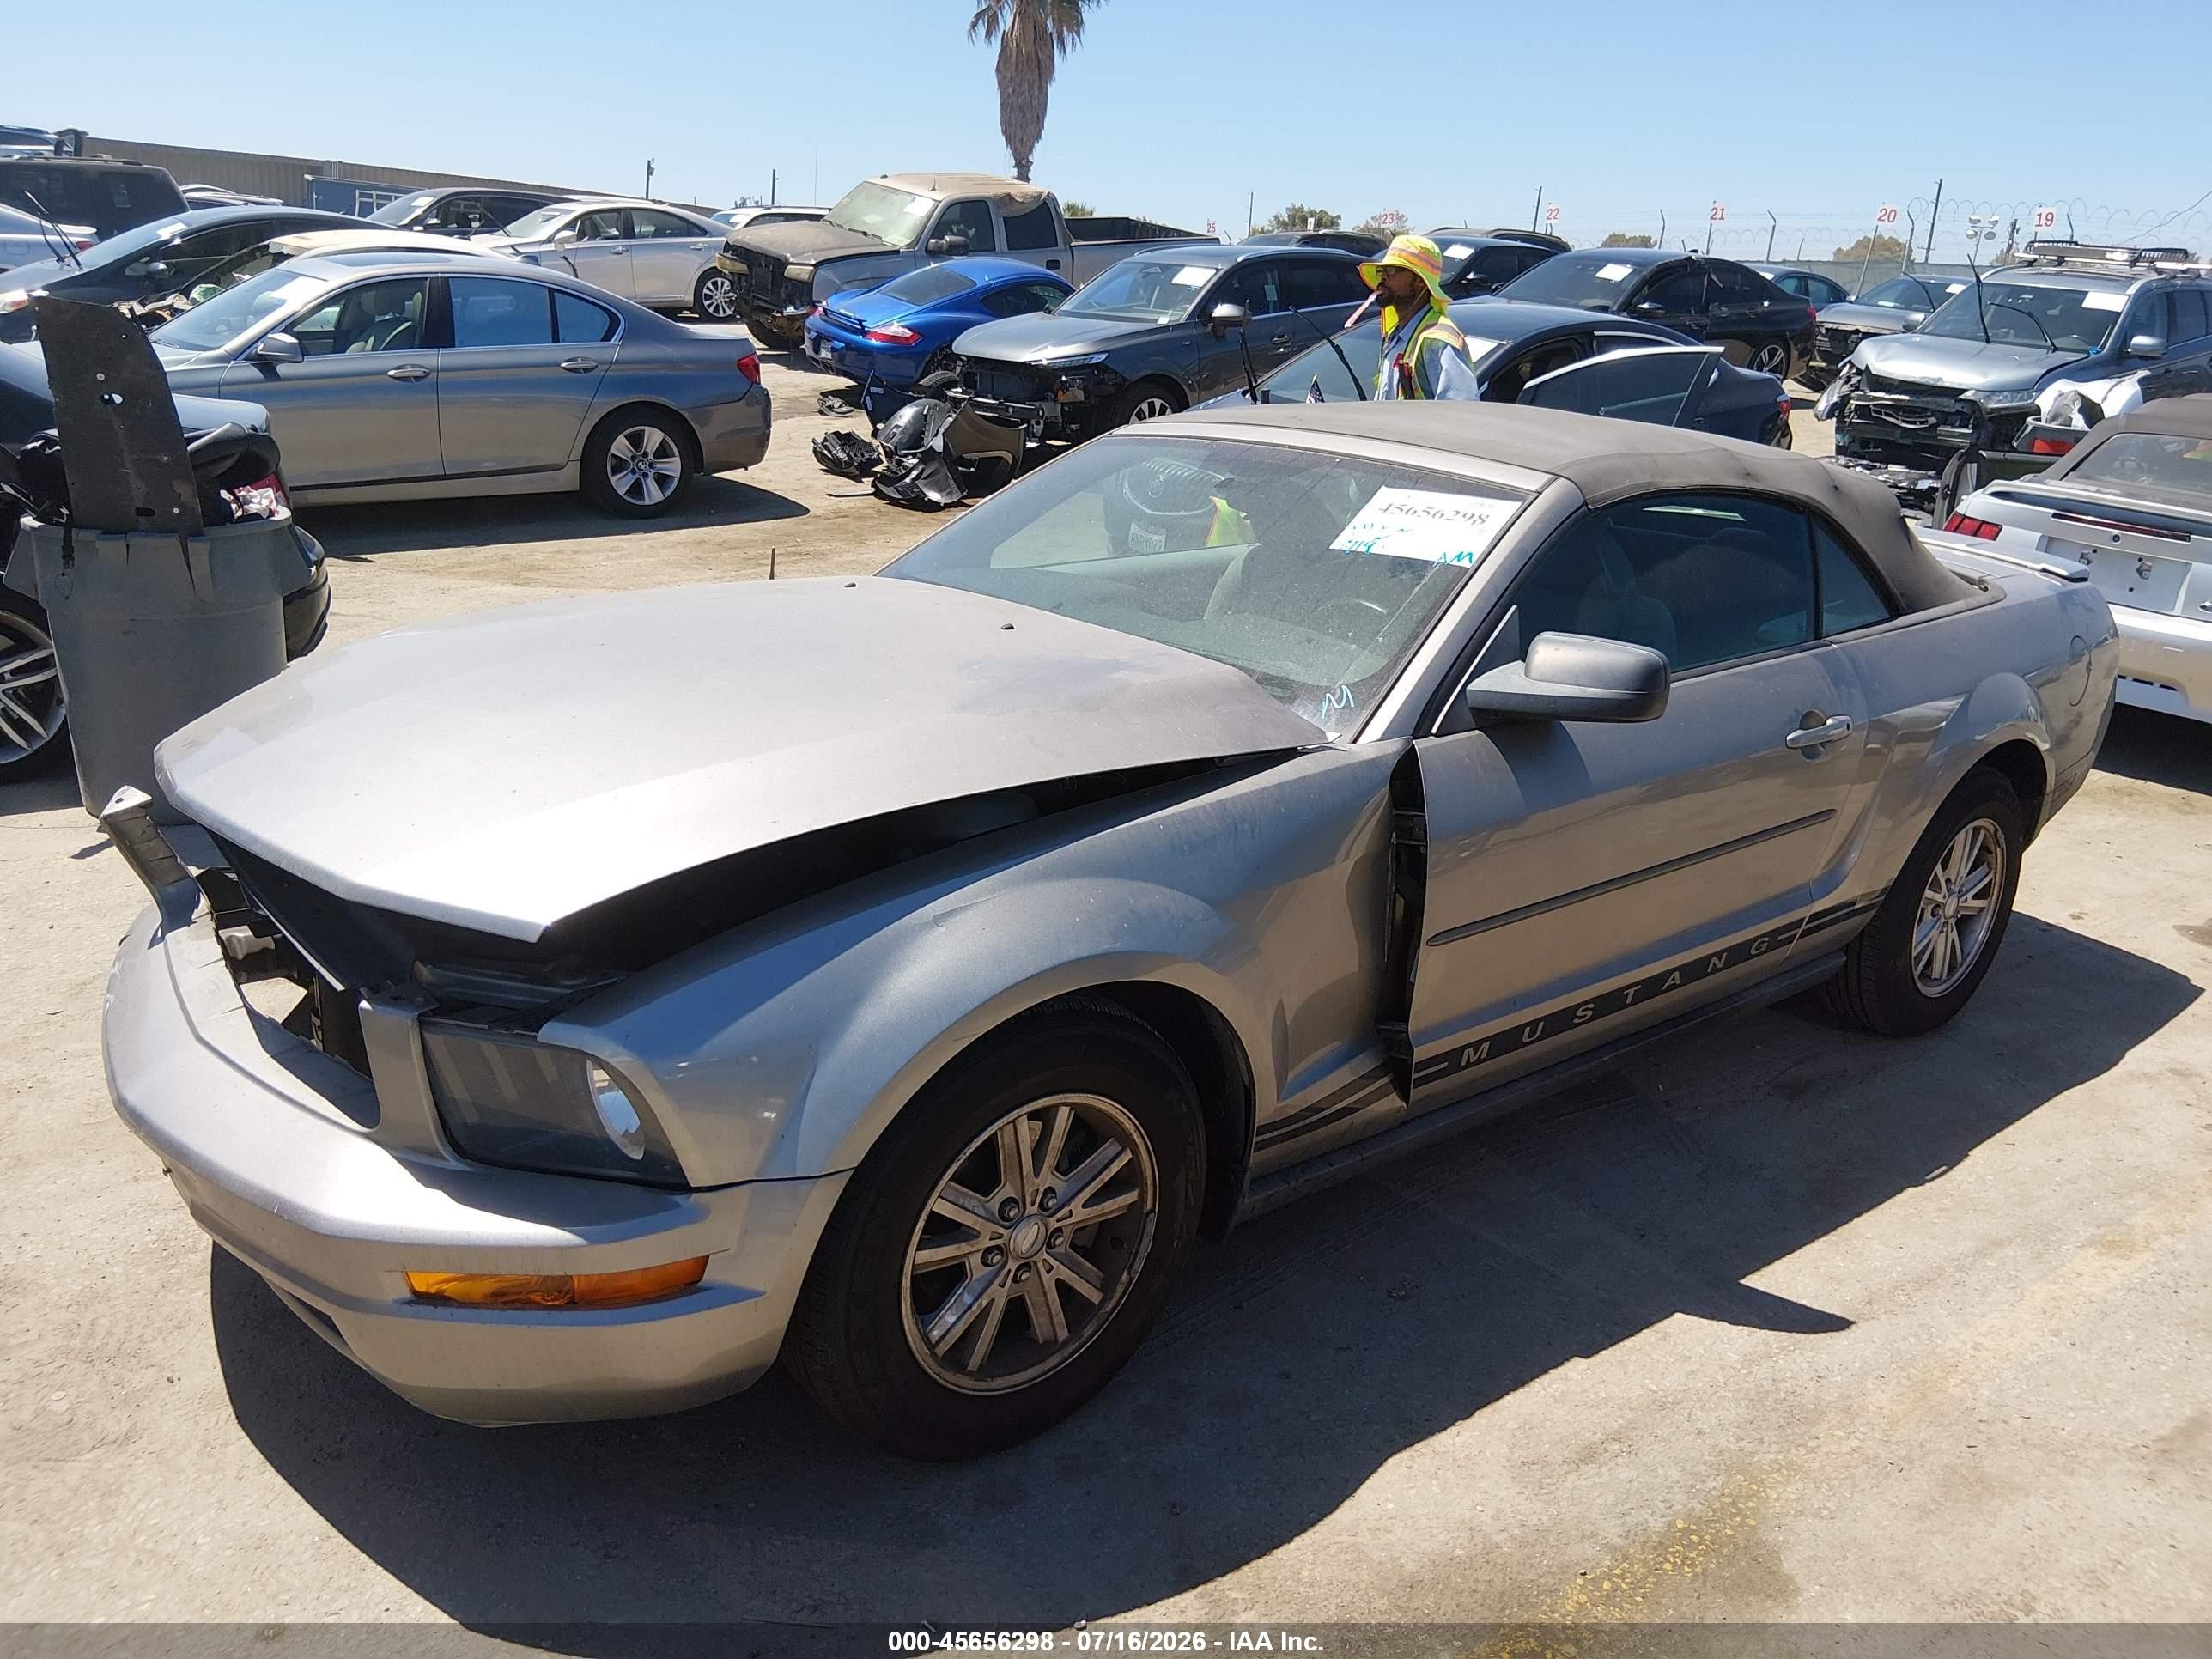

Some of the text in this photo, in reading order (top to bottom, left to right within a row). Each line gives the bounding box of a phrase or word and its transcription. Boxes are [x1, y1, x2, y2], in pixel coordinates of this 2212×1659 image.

[1382, 213, 1395, 224] 23
[1546, 208, 1559, 220] 22
[1710, 206, 1725, 220] 21
[1876, 208, 1897, 223] 20
[2034, 211, 2054, 228] 19
[1378, 502, 1490, 526] 45656298
[1460, 936, 1770, 1067] MUSTANG
